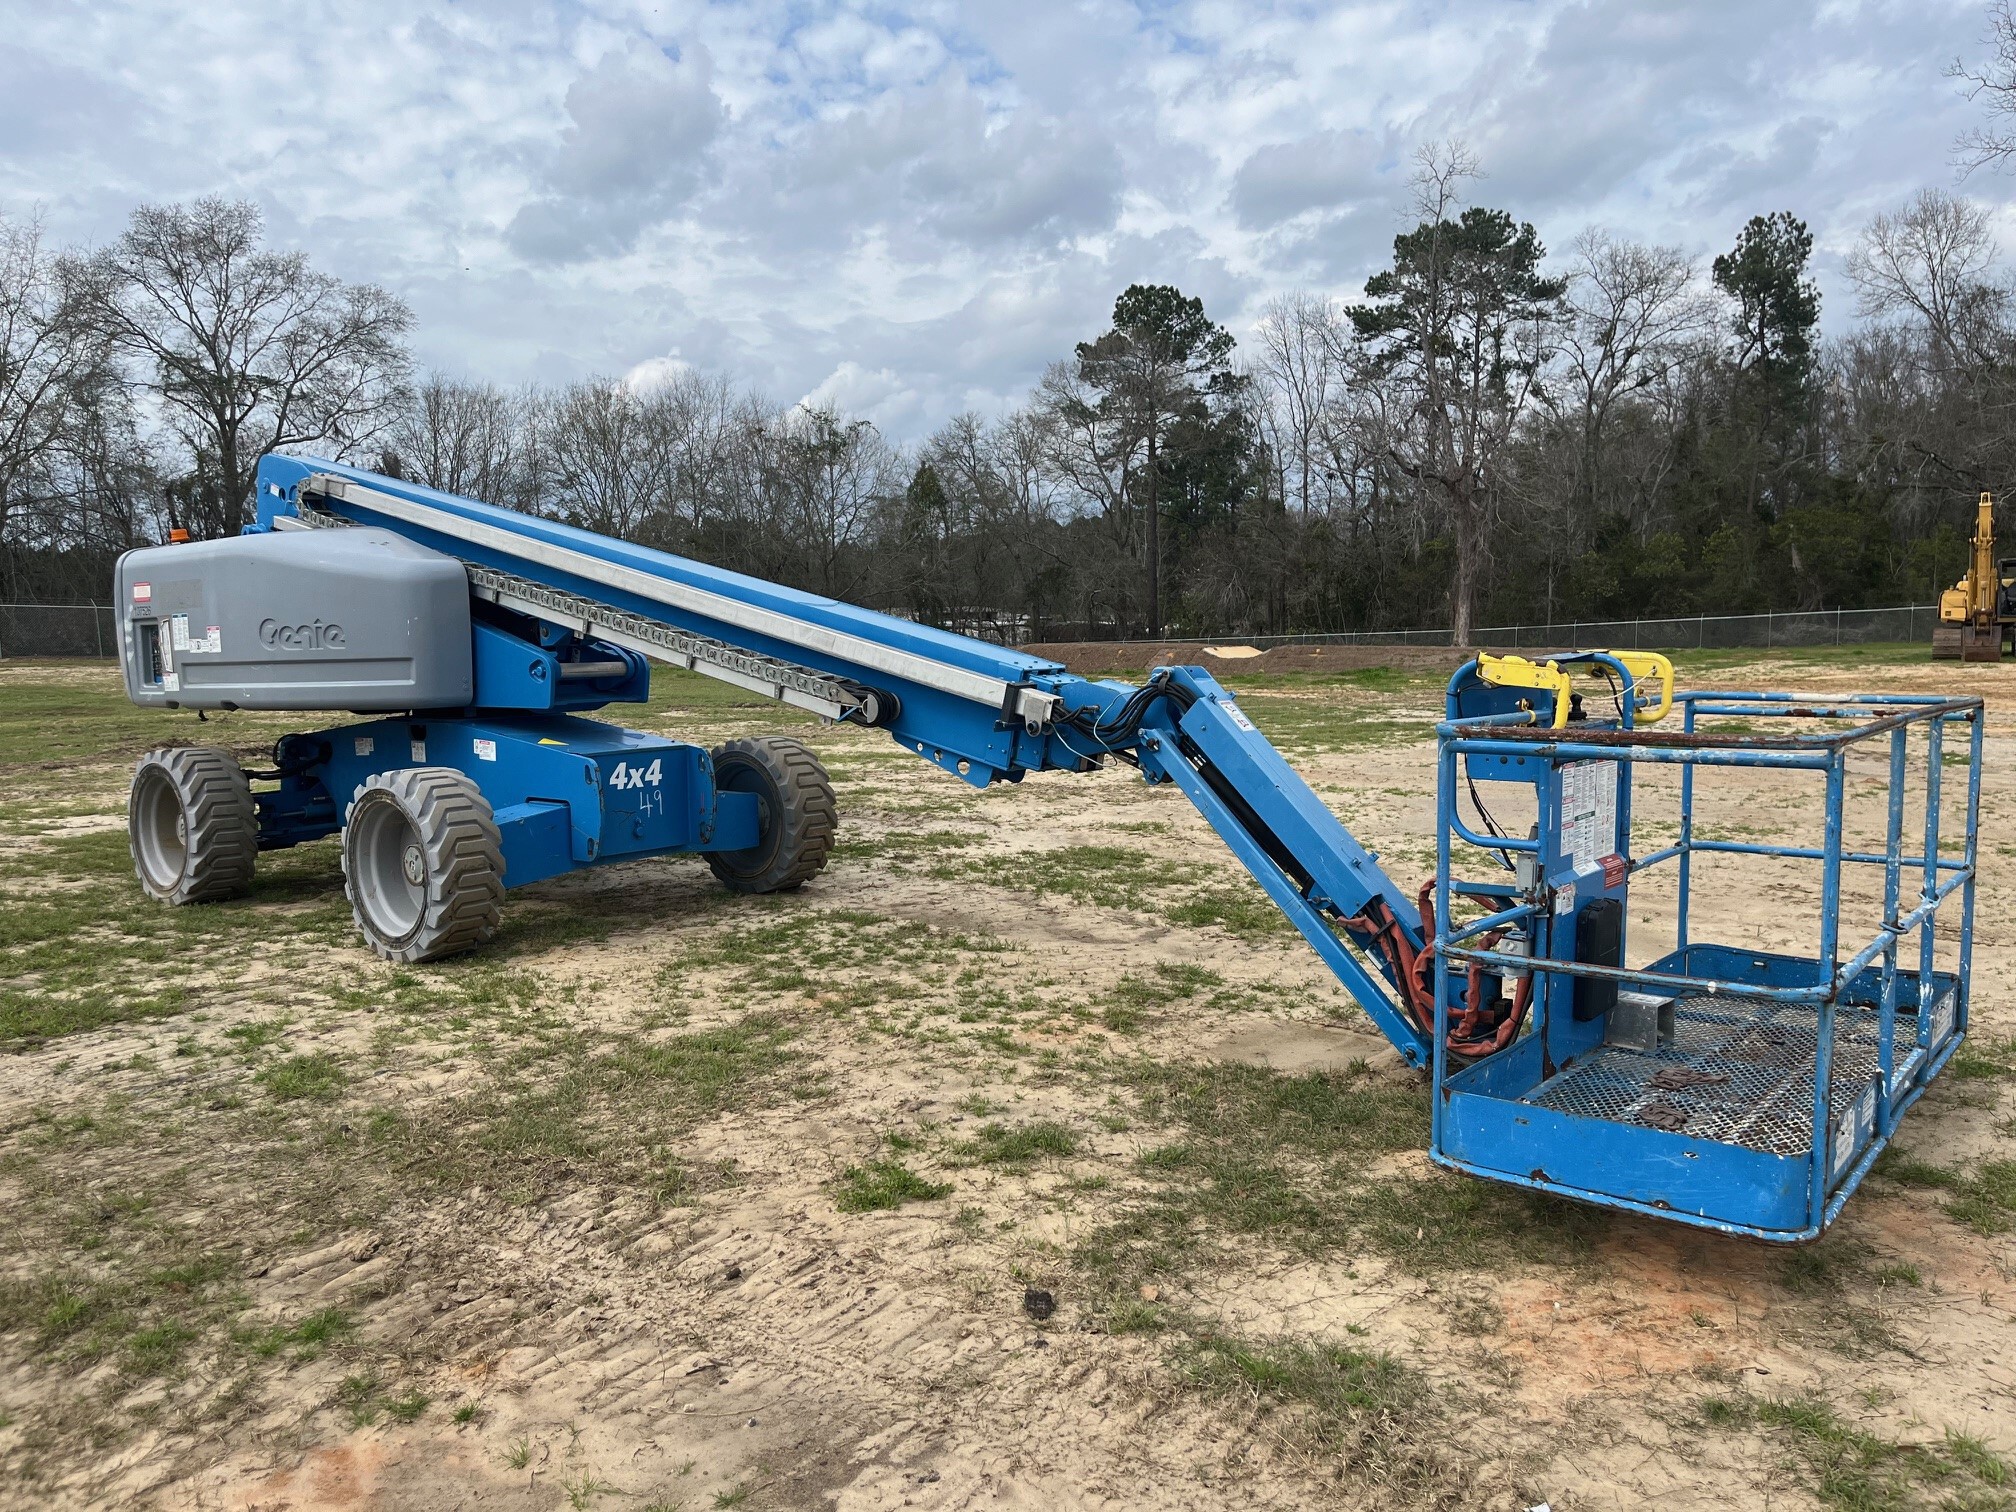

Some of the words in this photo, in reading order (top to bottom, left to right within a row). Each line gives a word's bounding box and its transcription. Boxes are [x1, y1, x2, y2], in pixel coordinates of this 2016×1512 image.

[259, 618, 345, 651] Genie
[609, 759, 662, 790] 4x4
[639, 789, 663, 818] 49
